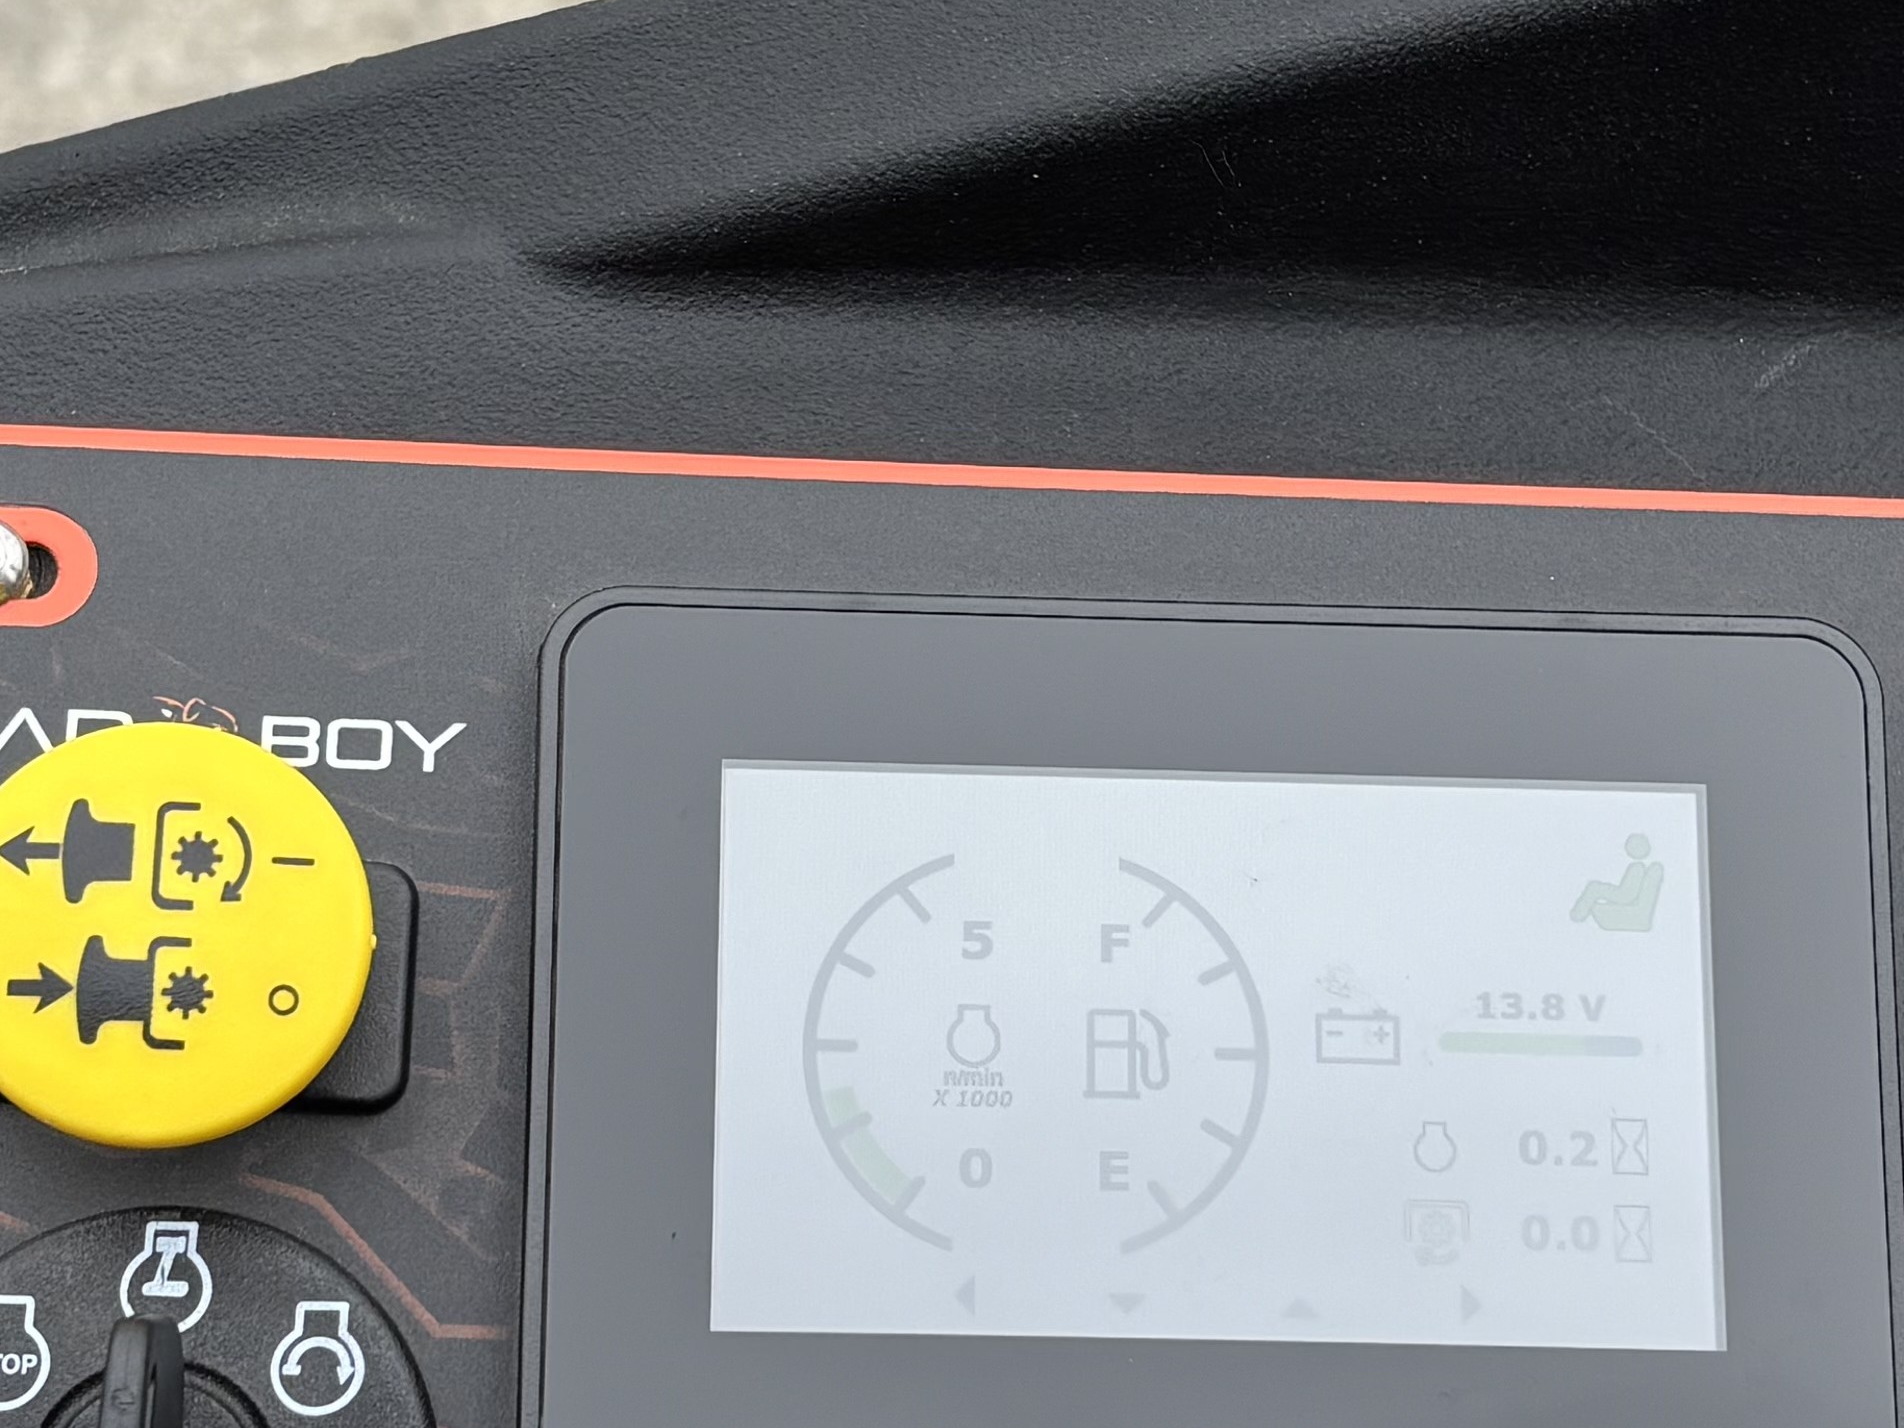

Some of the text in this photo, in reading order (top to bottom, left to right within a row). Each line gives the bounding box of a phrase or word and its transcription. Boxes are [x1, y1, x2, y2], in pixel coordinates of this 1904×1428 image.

[261, 715, 467, 772] BOY
[961, 922, 993, 959] 5
[1100, 925, 1131, 963] F
[1475, 993, 1605, 1021] 13.8 V
[956, 1090, 1014, 1108] 1000
[1520, 1130, 1598, 1167] 0.2
[959, 1149, 994, 1189] 0
[1098, 1151, 1130, 1191] E
[1523, 1215, 1599, 1252] 0.0
